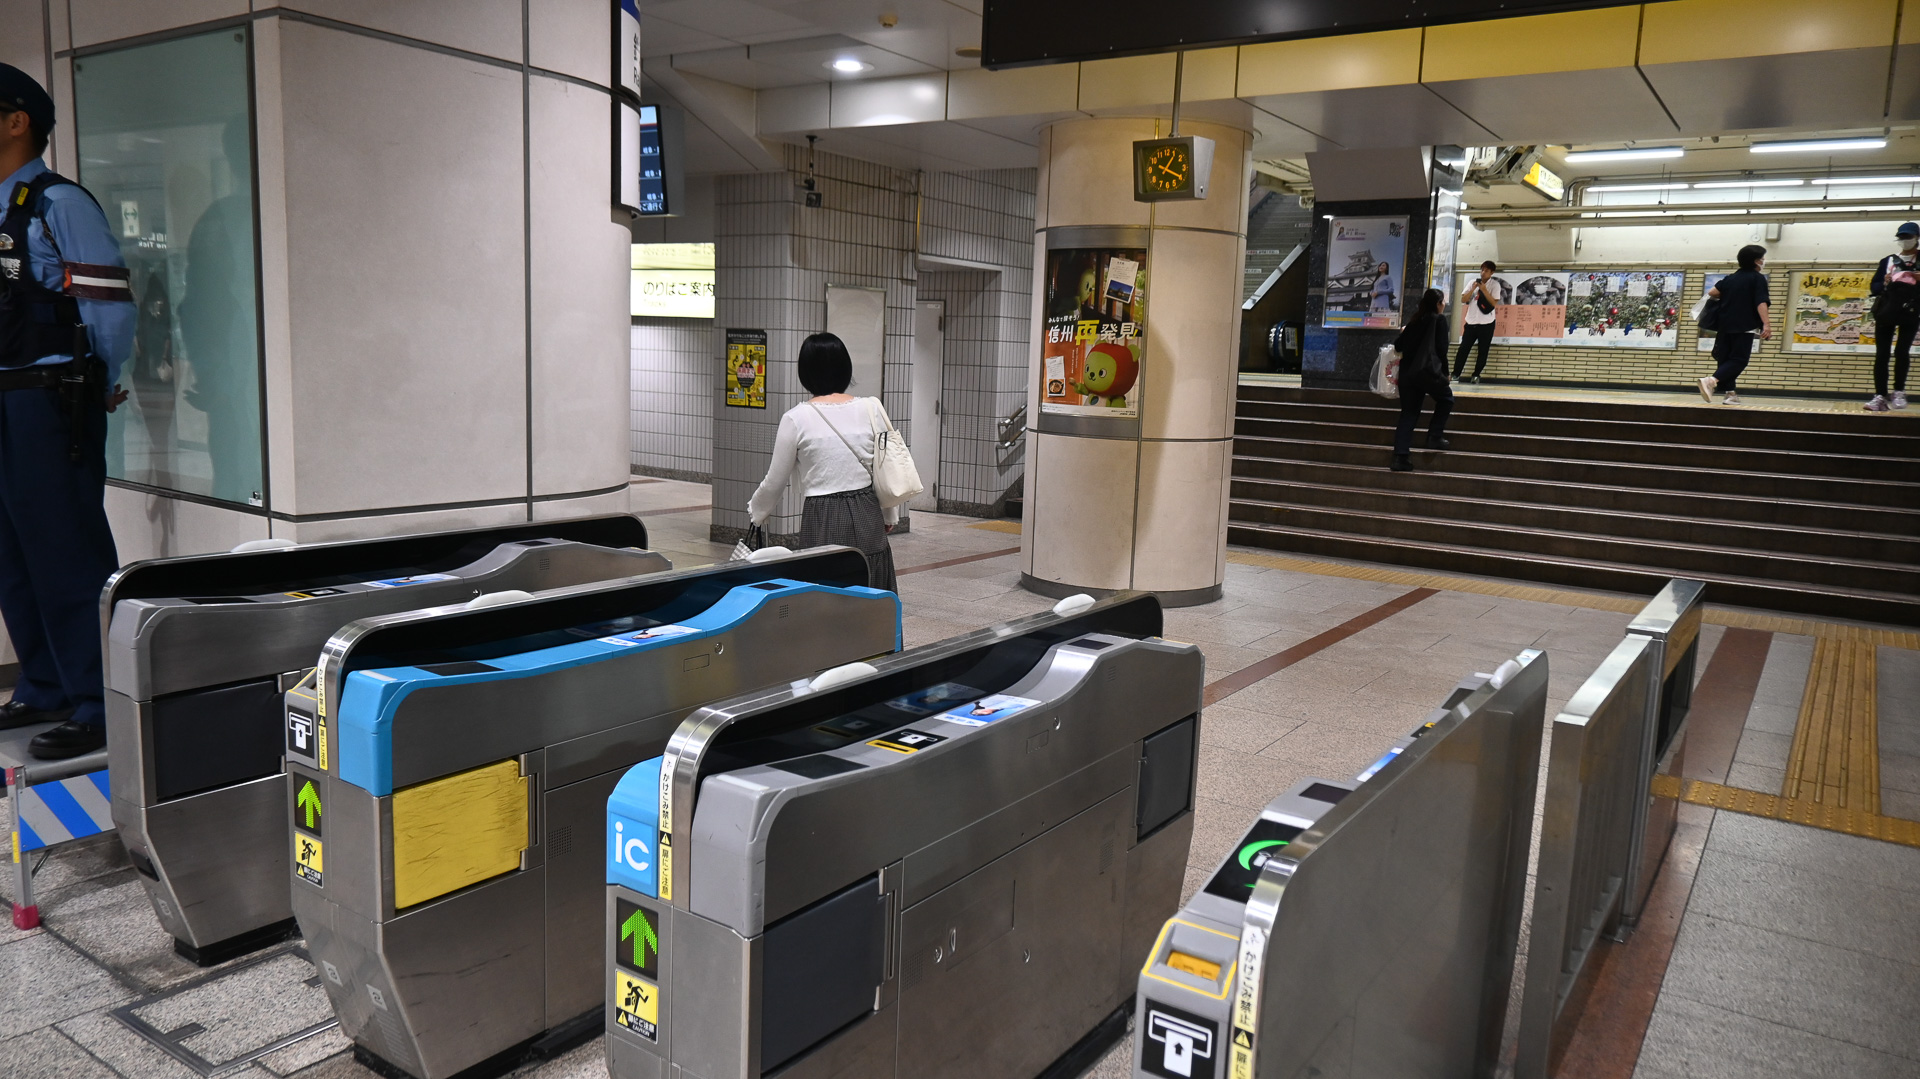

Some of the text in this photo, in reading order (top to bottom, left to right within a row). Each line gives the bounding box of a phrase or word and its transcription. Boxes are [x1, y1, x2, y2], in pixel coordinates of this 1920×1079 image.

[661, 772, 670, 830] かけこみ禁止
[614, 821, 650, 872] ic
[661, 848, 669, 896] 扉にご注意
[1240, 951, 1256, 1026] かけこみ禁止
